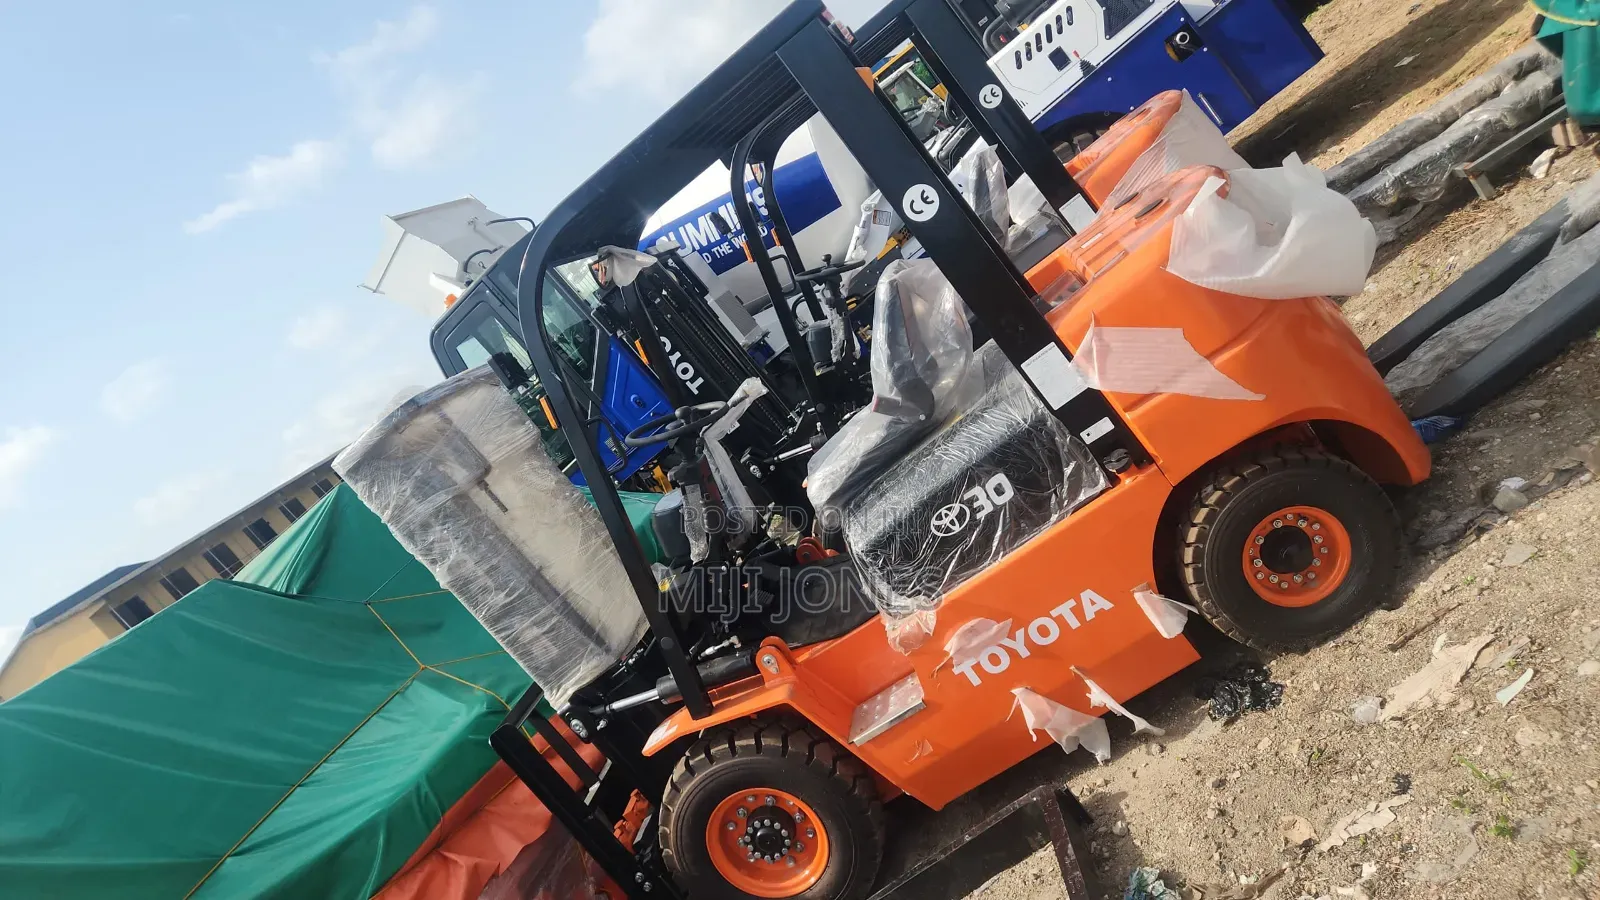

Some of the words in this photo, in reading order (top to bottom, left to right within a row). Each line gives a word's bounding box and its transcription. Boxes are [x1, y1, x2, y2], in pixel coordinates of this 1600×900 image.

[711, 241, 733, 260] THE
[963, 472, 1014, 519] 30
[951, 588, 1115, 687] TOYOTA
